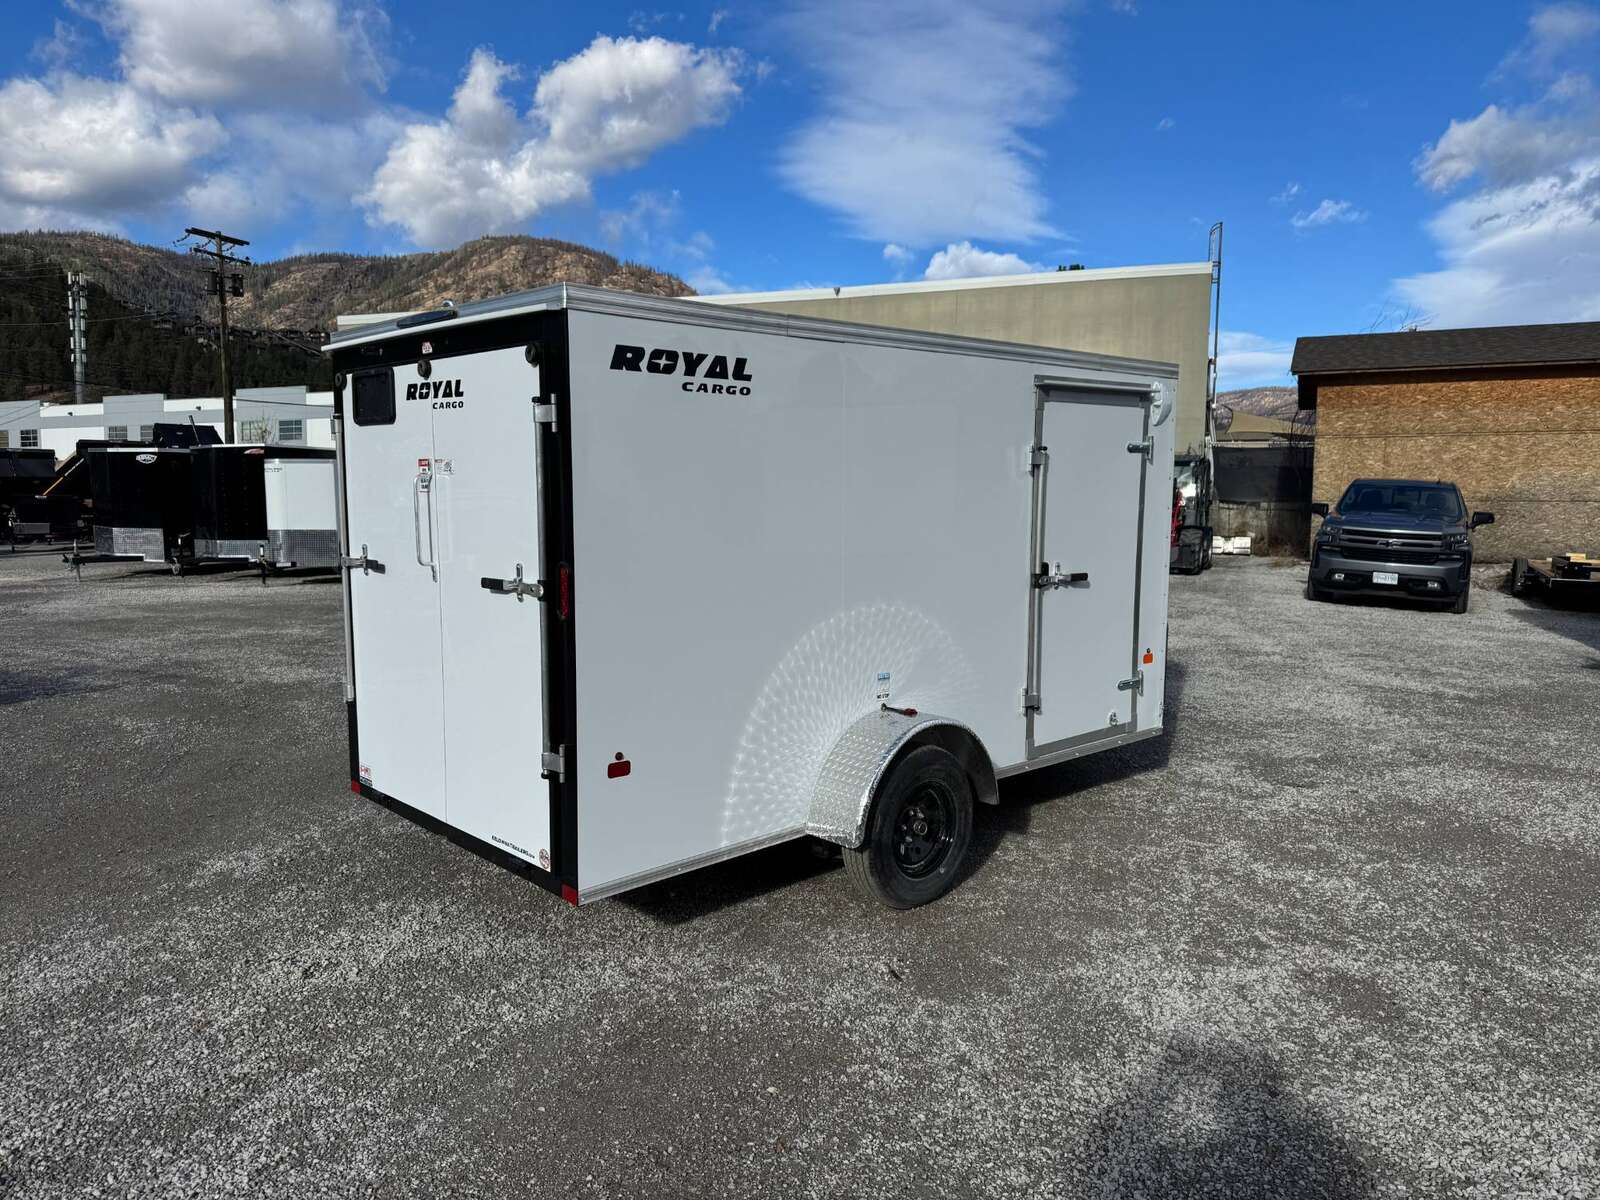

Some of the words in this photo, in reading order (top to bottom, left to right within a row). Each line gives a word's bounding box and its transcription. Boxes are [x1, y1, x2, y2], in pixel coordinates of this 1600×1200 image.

[609, 344, 753, 382] ROYAL
[406, 379, 464, 401] ROYAL
[682, 382, 751, 396] CARGO
[432, 401, 464, 409] CARGO
